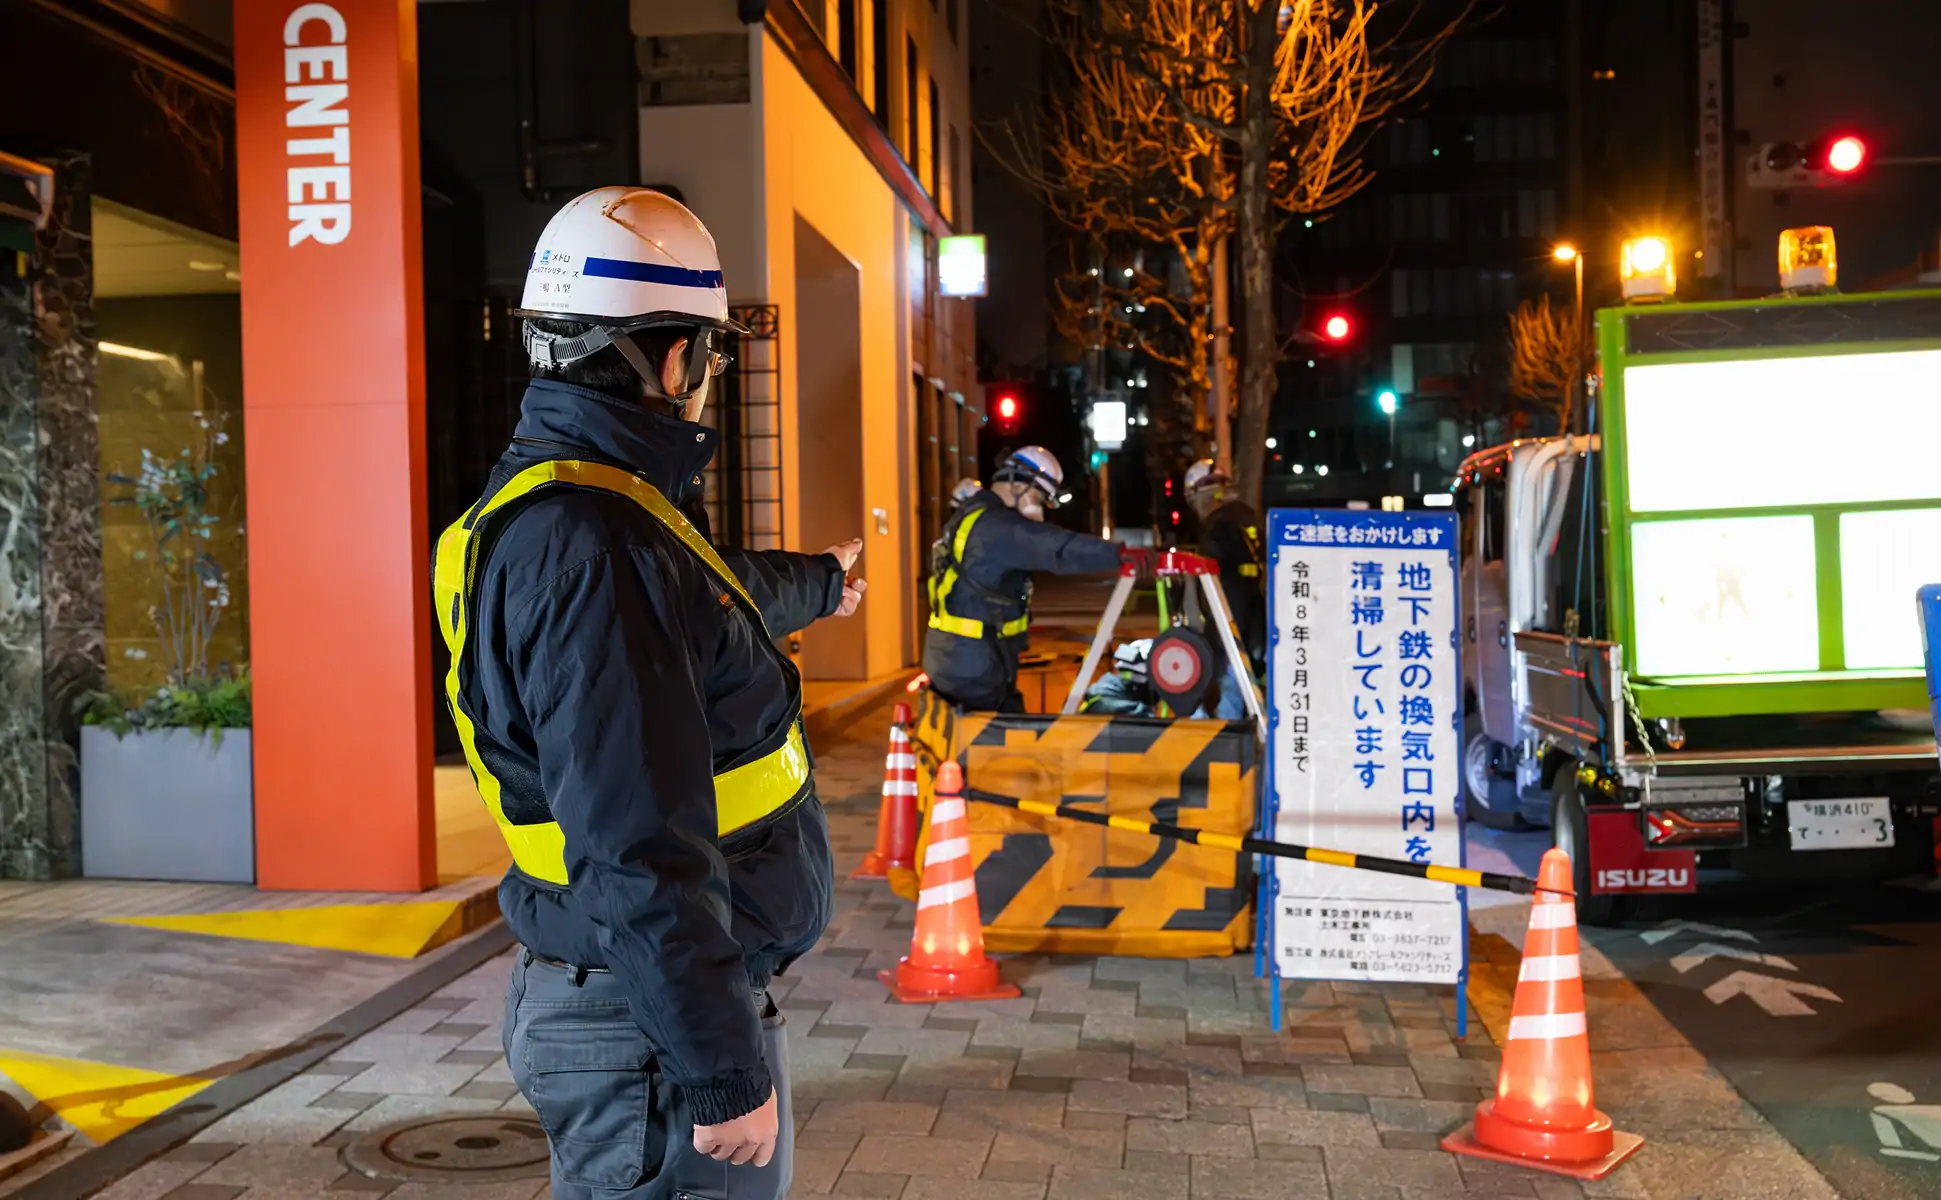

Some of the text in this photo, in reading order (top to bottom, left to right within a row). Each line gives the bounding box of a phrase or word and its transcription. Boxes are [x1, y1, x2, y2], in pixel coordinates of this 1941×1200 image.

[283, 2, 351, 248] CENTER
[1284, 524, 1443, 545] ご迷惑をおかけします
[1290, 561, 1310, 772] 令和8年3月31日まで
[1352, 561, 1385, 789] 清掃しています
[1398, 562, 1435, 865] 地下鉄の換気口内を
[1598, 868, 1688, 888] ISUZU
